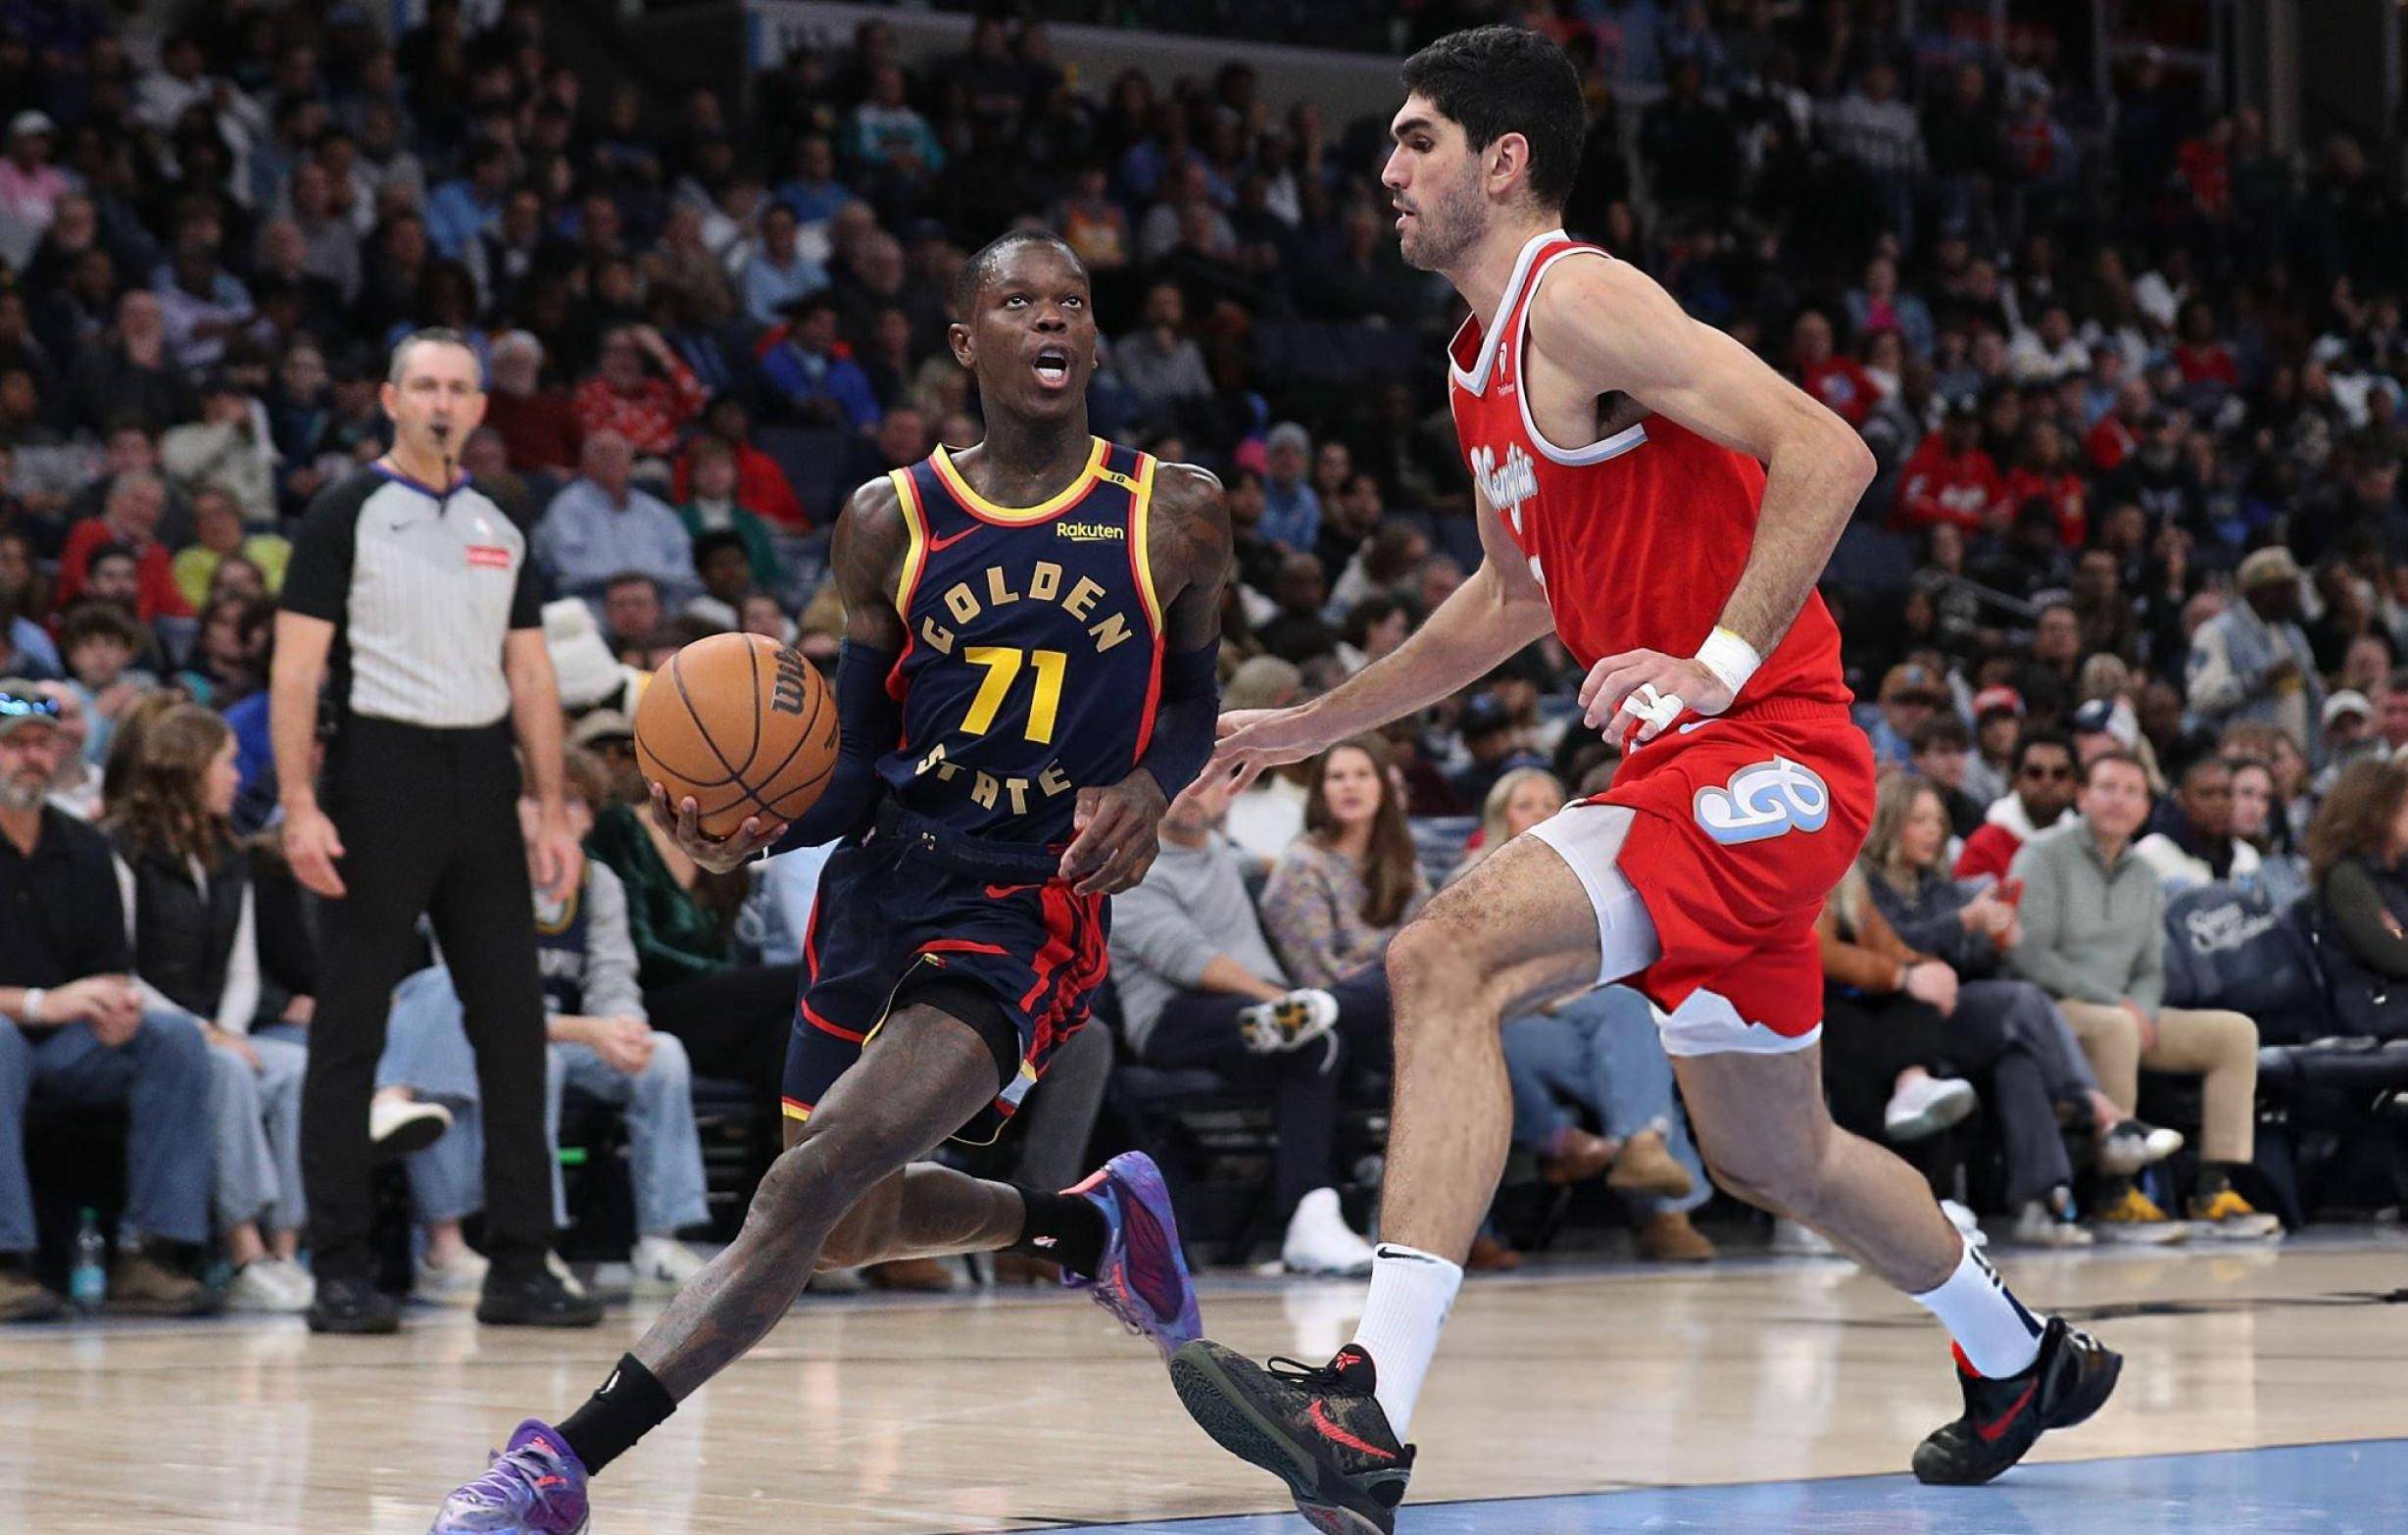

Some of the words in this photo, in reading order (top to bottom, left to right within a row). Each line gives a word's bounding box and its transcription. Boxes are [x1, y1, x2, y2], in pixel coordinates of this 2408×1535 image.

[1056, 521, 1125, 540] Rakuten
[921, 560, 1132, 655] GOLDEN
[958, 646, 1067, 745] 71
[914, 742, 1072, 816] STATE
